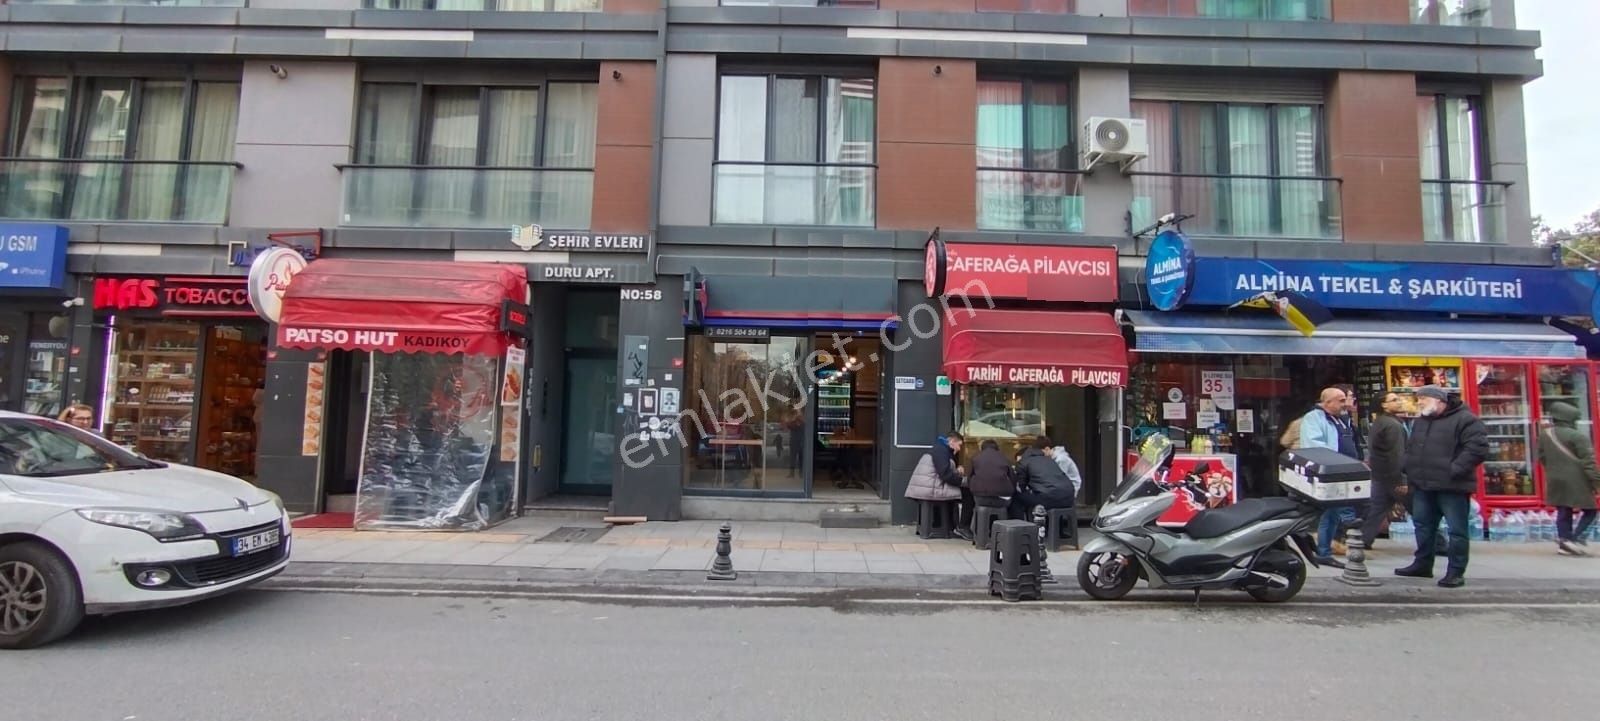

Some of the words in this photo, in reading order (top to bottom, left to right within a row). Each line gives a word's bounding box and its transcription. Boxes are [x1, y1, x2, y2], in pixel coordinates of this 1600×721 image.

[8, 235, 38, 252] GSM
[545, 267, 582, 279] DURU
[585, 268, 615, 279] APT.
[1034, 256, 1111, 276] PİLAVCISI
[1235, 270, 1314, 292] ALMİNA
[1319, 275, 1384, 294] TEKEL
[1388, 278, 1403, 295] &
[1408, 277, 1523, 299] ŞARKÜTERİ
[92, 278, 160, 309] HAS
[163, 288, 251, 305] TOBACC
[621, 288, 662, 300] NO:58
[285, 328, 349, 344] PATSO
[354, 330, 399, 346] HUT
[967, 364, 1002, 381] TARİHİ
[1009, 366, 1064, 383] CAFERAĞA
[1071, 367, 1121, 385] PİLAVCISI
[1204, 379, 1223, 392] 35
[239, 538, 249, 551] 34
